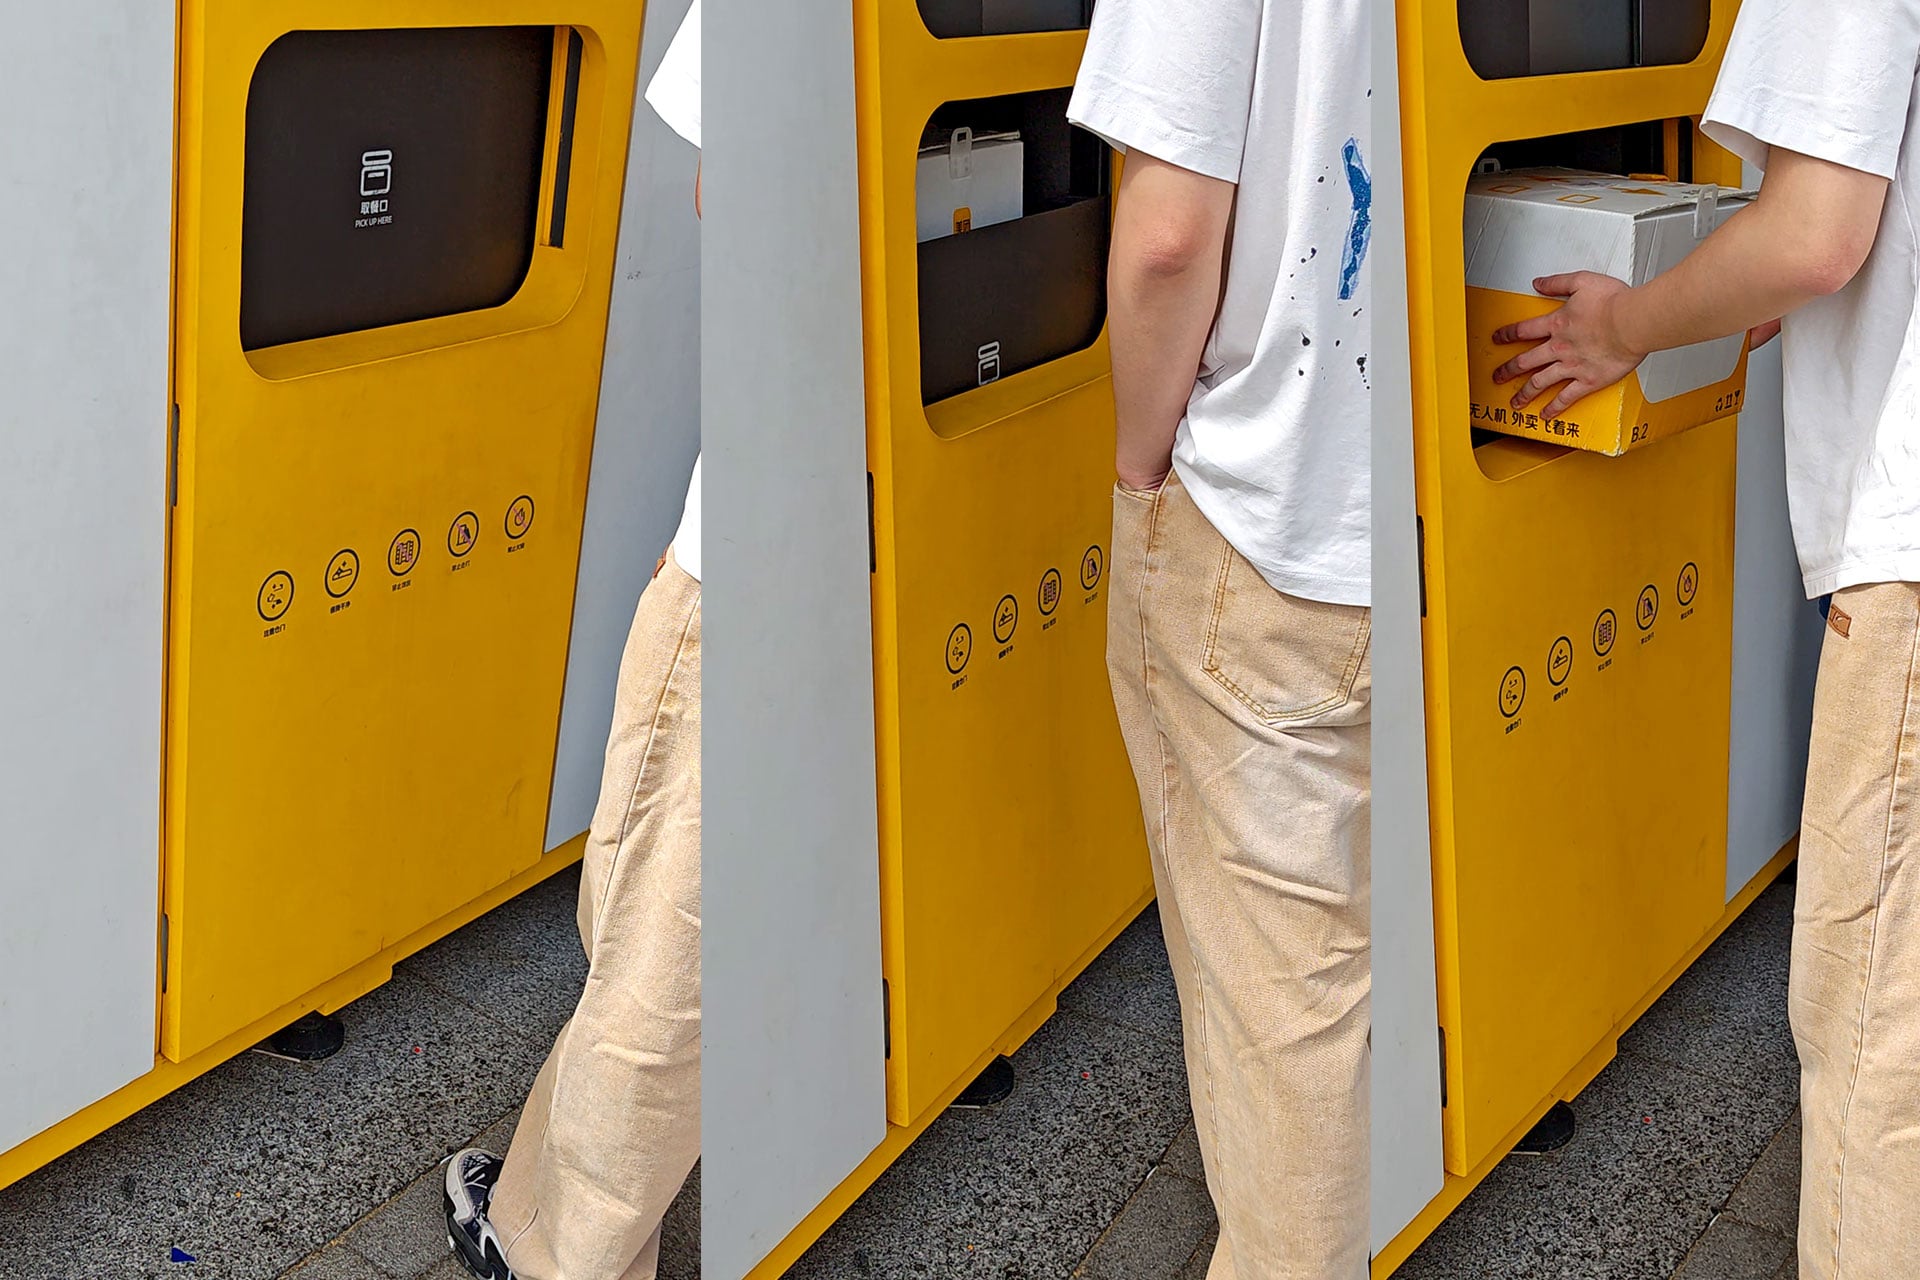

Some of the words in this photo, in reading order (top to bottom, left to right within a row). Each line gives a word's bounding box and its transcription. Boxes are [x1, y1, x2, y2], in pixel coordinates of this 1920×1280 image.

[360, 199, 388, 215] 取餐口
[355, 218, 368, 228] PICK
[369, 217, 378, 226] UP
[377, 215, 393, 225] HERE
[1470, 402, 1507, 425] 无人机
[1631, 422, 1649, 443] B.2
